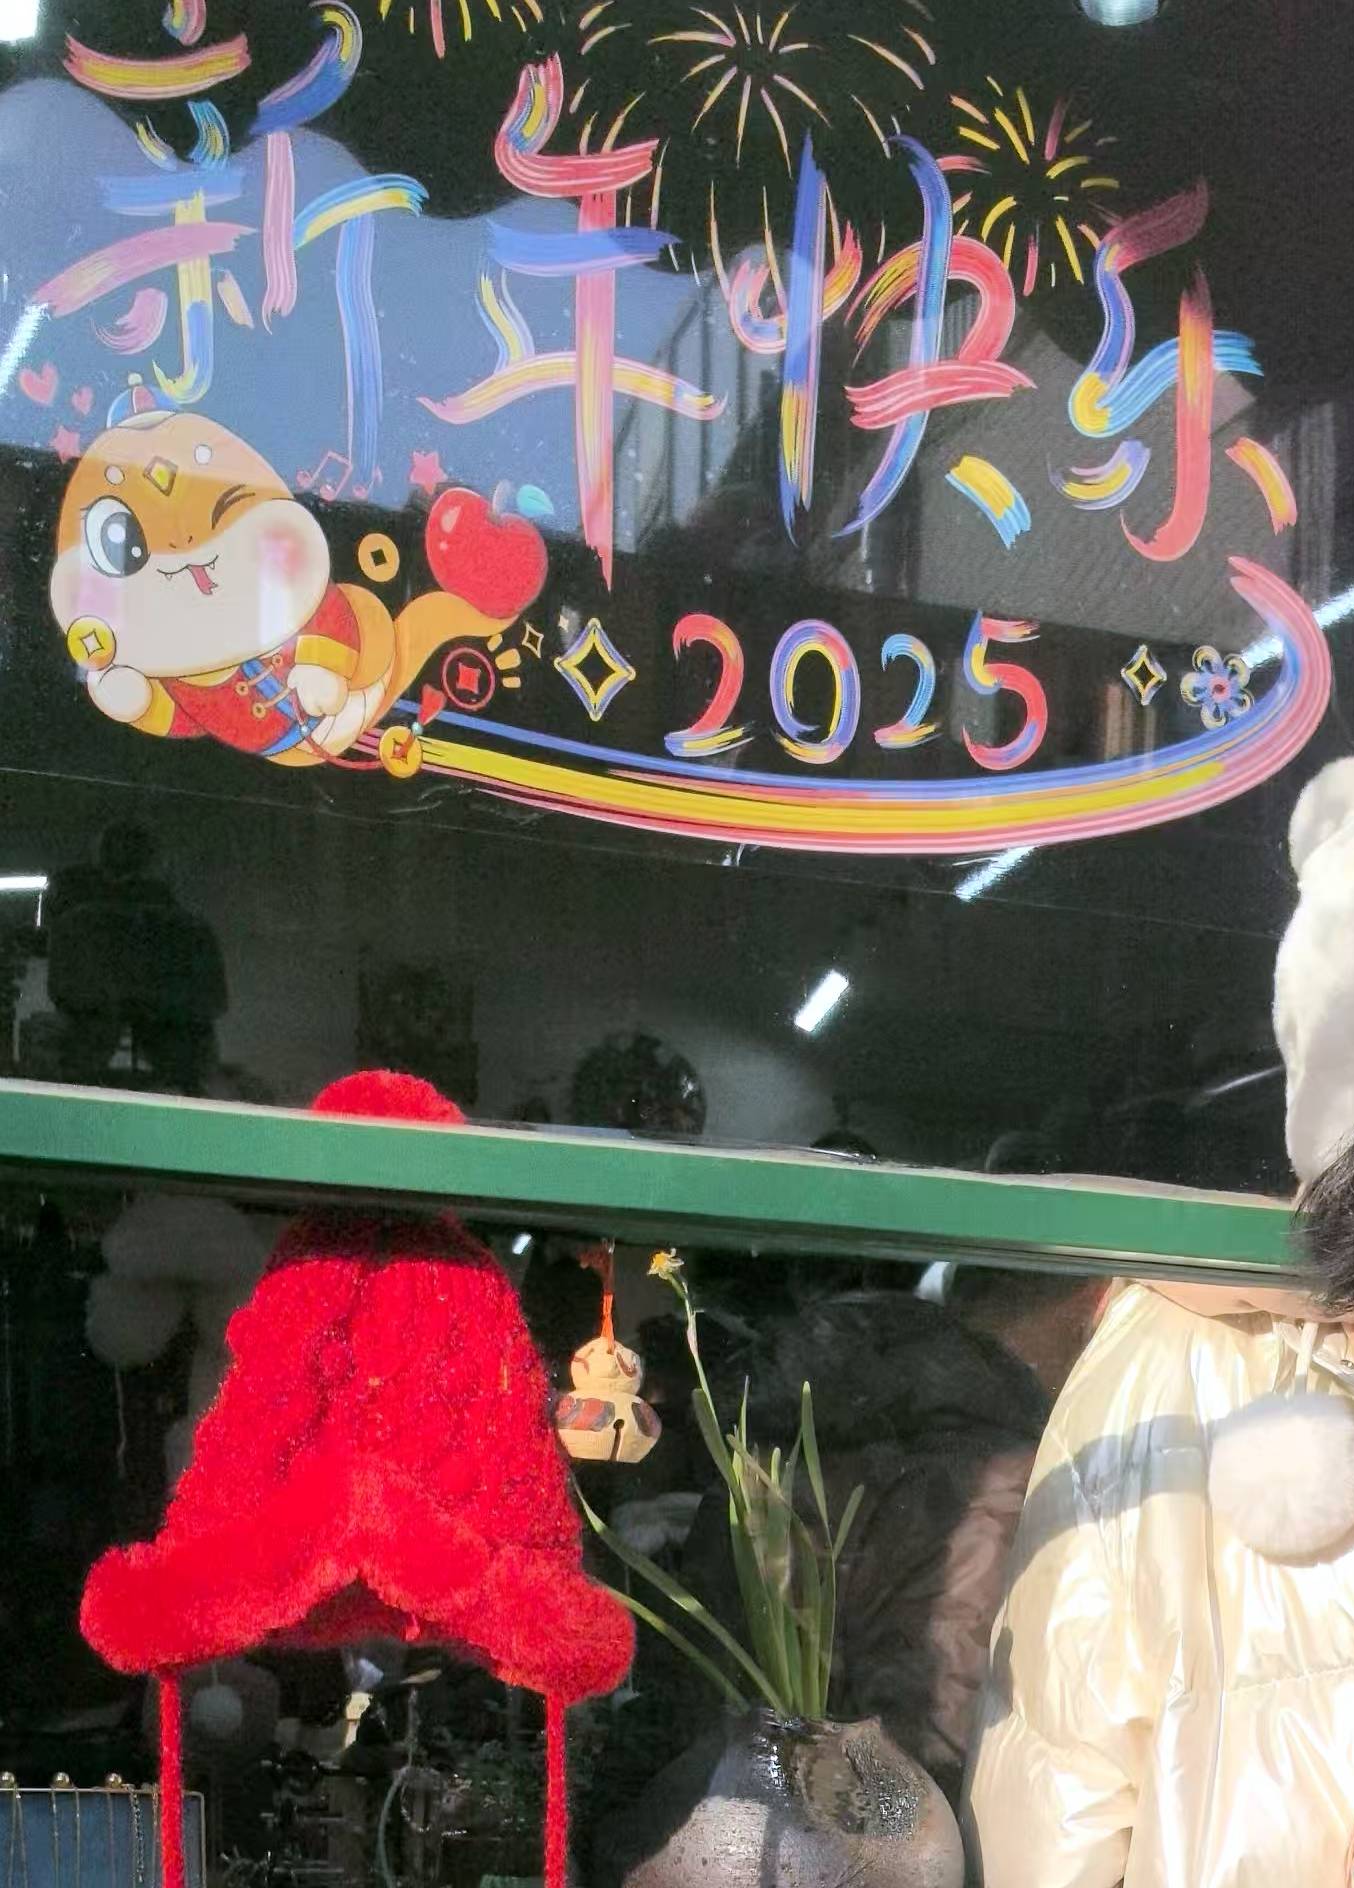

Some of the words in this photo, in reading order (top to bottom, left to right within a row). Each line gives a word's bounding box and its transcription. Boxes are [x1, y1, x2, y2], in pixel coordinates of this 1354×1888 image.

[32, 0, 1298, 591] 新年快乐
[664, 609, 1048, 771] 2025
